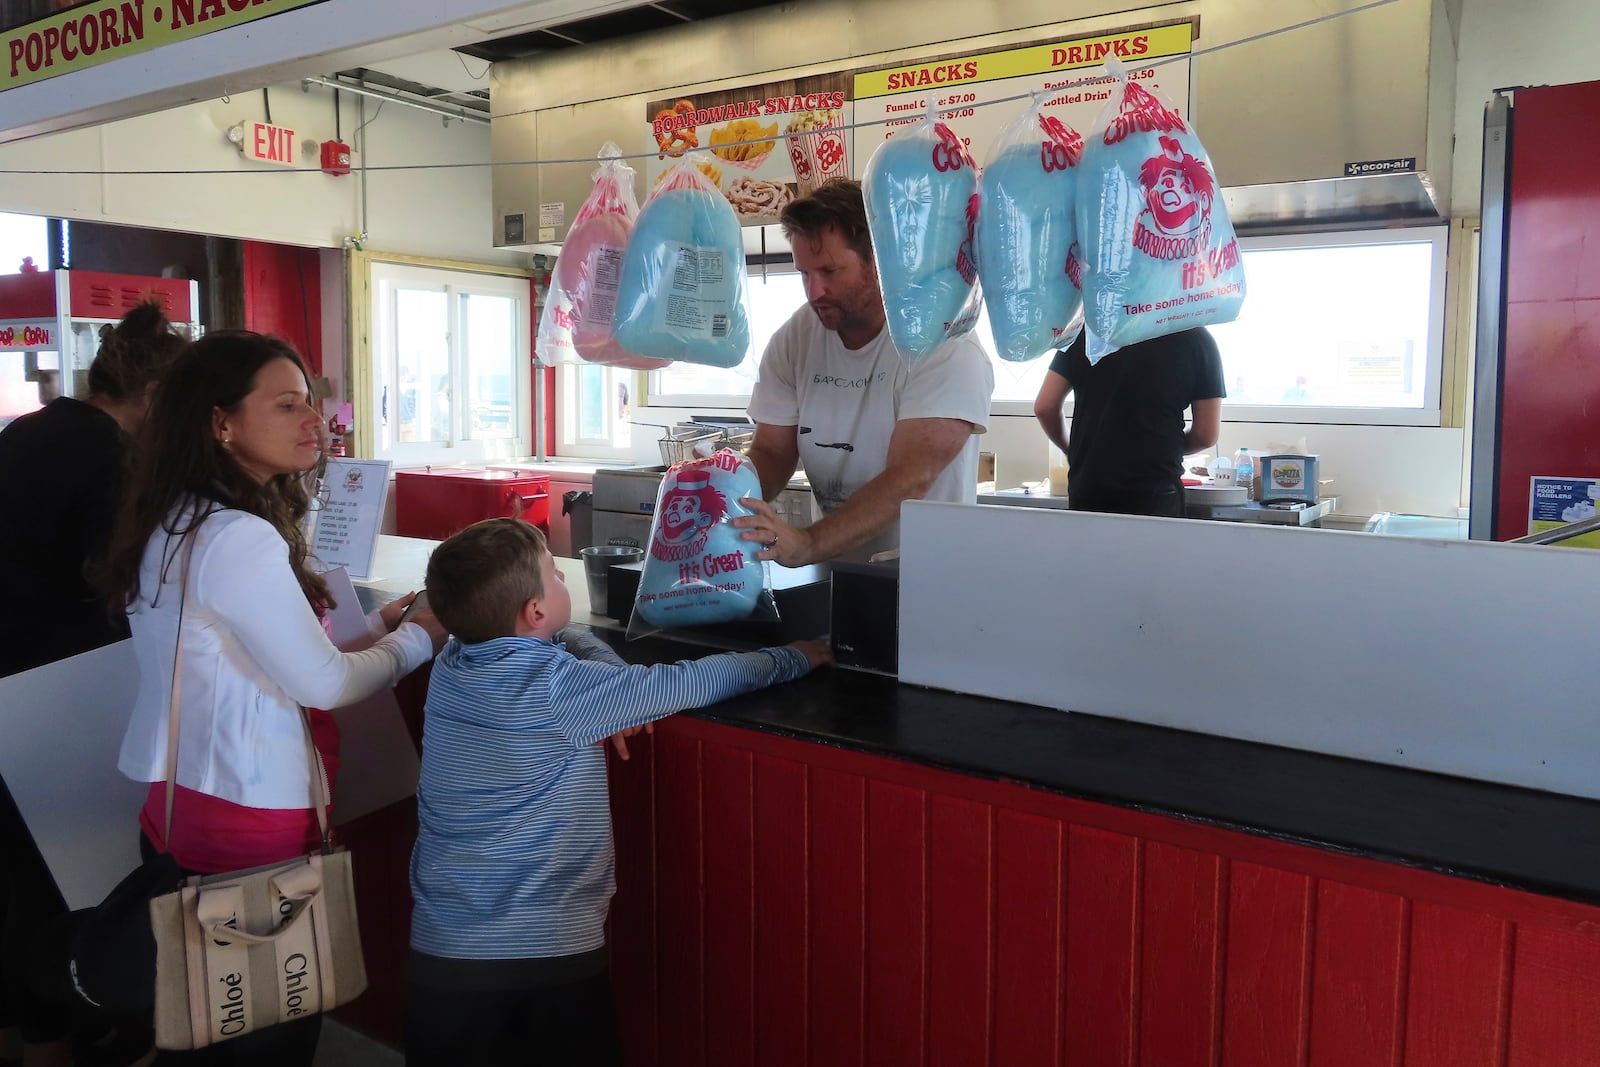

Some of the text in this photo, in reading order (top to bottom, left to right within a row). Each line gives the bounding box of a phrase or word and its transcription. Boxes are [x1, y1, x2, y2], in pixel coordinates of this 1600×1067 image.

[9, 0, 144, 77] POPCORN
[1051, 36, 1148, 66] DRINKS
[887, 62, 978, 90] SNACKS
[653, 91, 845, 136] BOARDWALK SNACKS
[885, 101, 917, 113] Funnel
[948, 93, 976, 106] $7.00
[254, 123, 295, 163] EXIT
[1362, 160, 1410, 171] econ-air
[1123, 304, 1152, 316] Take
[1155, 297, 1185, 310] some
[1187, 290, 1214, 303] home
[24, 326, 49, 346] CORN
[678, 550, 745, 584] it's Great
[659, 589, 685, 600] some
[686, 584, 713, 595] home
[283, 952, 310, 1018] Chloé
[219, 971, 246, 1037] Chloé
